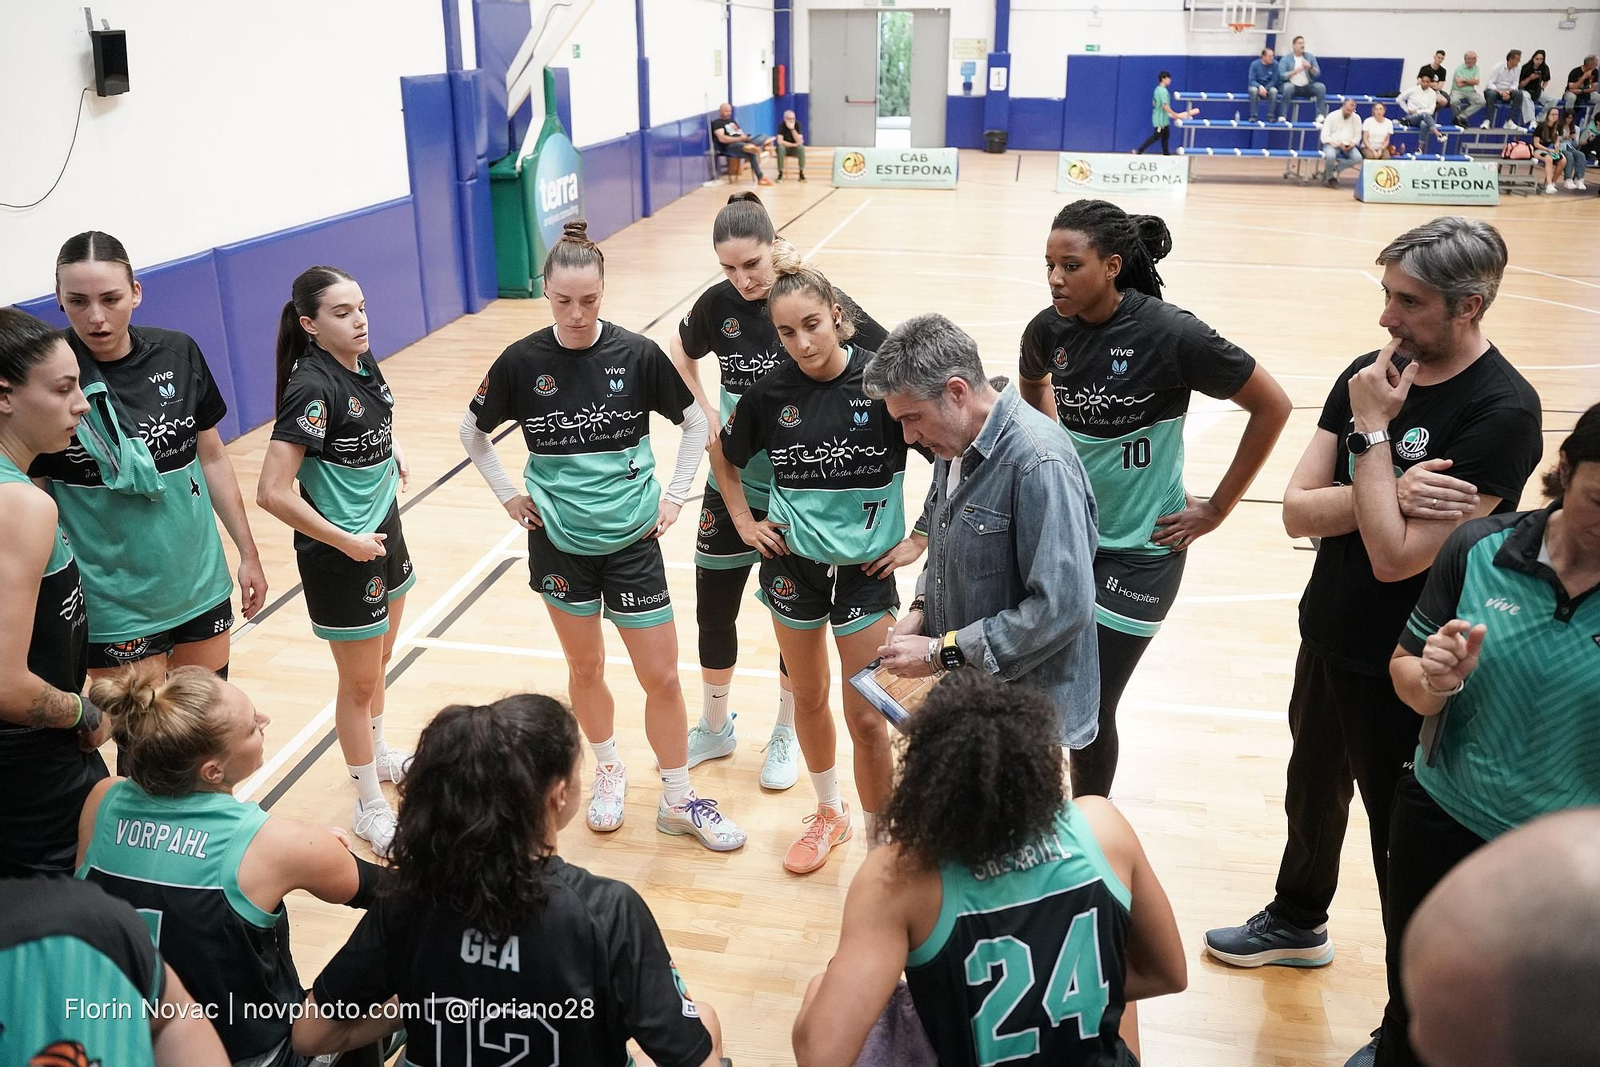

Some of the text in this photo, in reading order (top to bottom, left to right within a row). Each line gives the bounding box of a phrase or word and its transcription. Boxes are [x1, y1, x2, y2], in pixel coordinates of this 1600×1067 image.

[900, 153, 928, 162] CAB
[876, 164, 952, 176] ESTEPONA
[1128, 162, 1158, 172] CAB
[1437, 166, 1468, 177] CAB
[1102, 173, 1182, 184] ESTEPONA
[1412, 179, 1496, 190] ESTEPONA
[539, 172, 578, 212] terra
[1110, 346, 1134, 356] vive
[604, 366, 626, 374] vive
[148, 370, 174, 384] vive
[849, 398, 872, 407] vive
[588, 432, 610, 442] Costa
[1121, 436, 1152, 470] 10
[830, 468, 852, 478] Costa
[854, 466, 866, 475] del
[867, 464, 883, 474] Sol
[550, 590, 566, 599] ive
[1118, 586, 1160, 604] Hospiten
[774, 598, 792, 612] vive
[1485, 598, 1521, 616] vive
[371, 606, 386, 618] vive
[1402, 761, 1414, 770] vi
[115, 818, 210, 860] VORPAHL
[460, 928, 520, 973] GEA
[964, 907, 1110, 1067] 24
